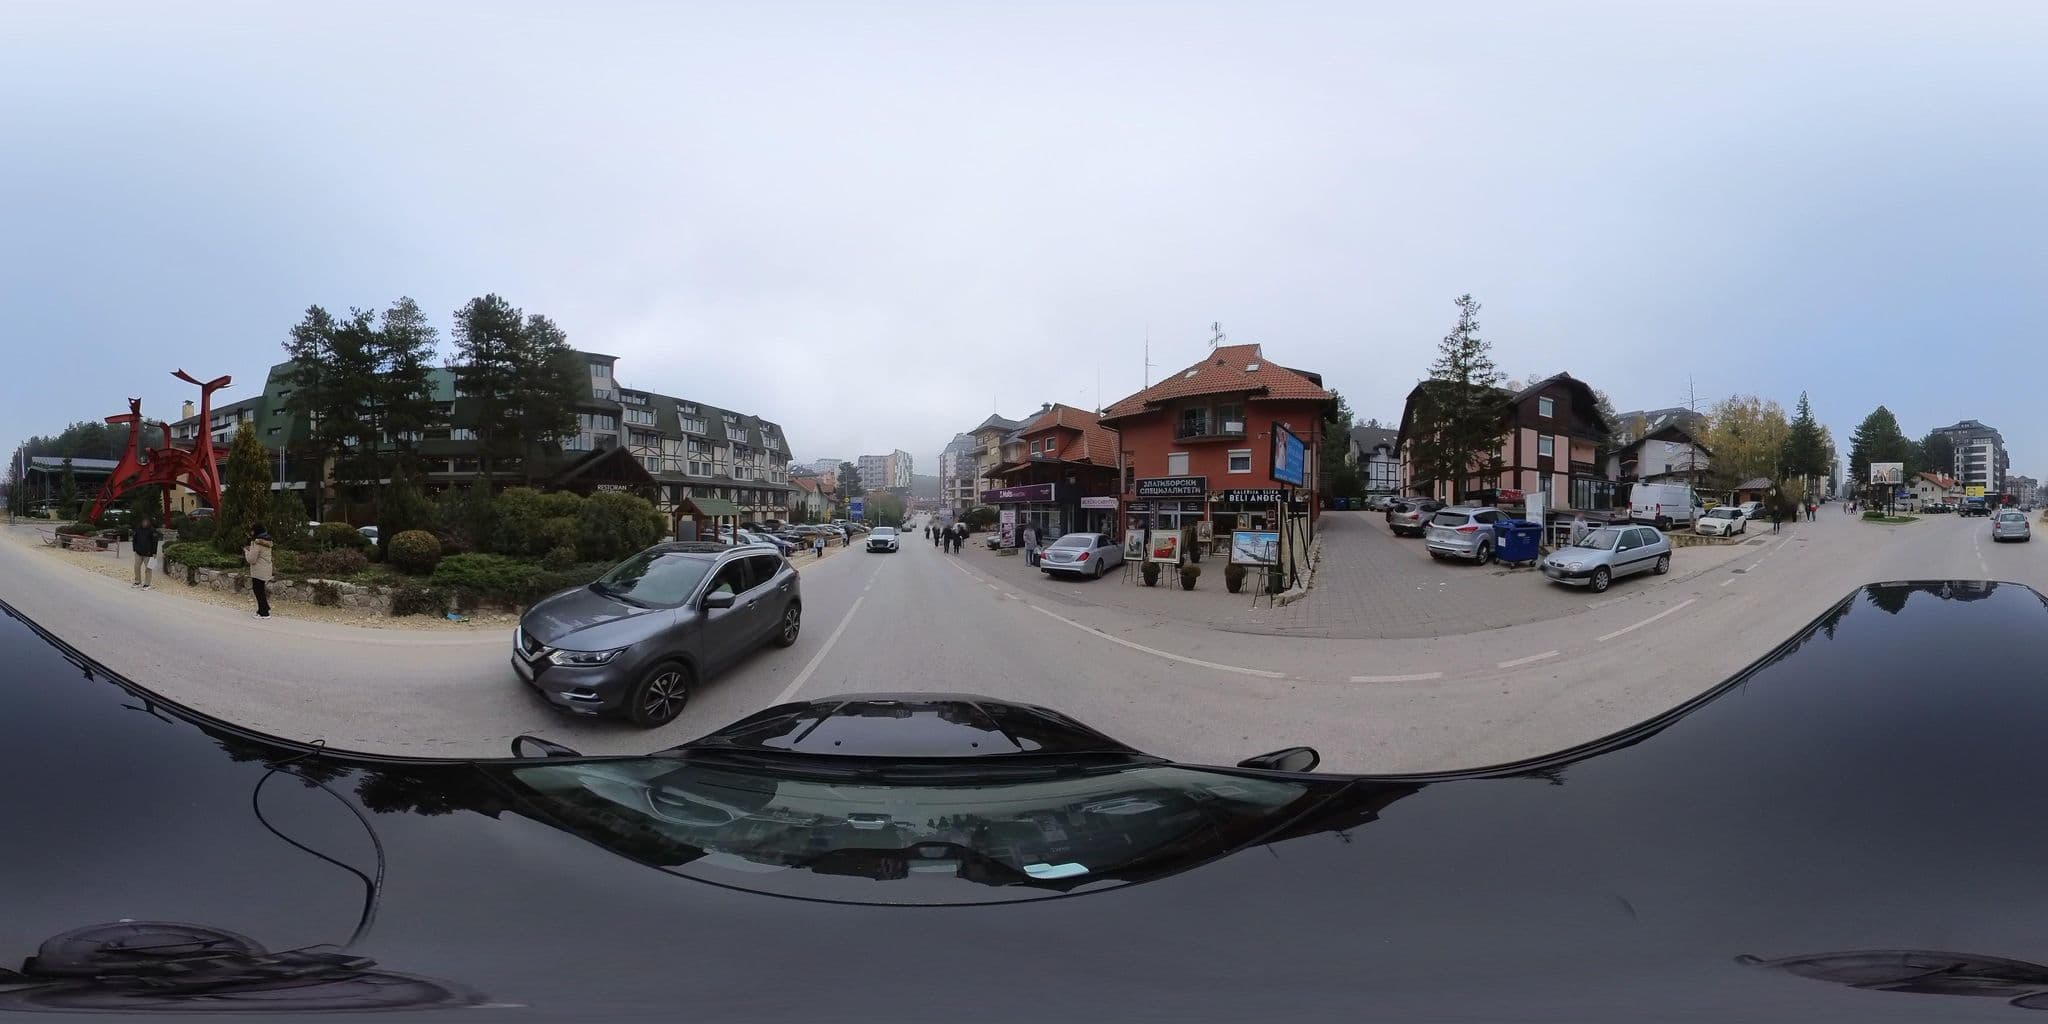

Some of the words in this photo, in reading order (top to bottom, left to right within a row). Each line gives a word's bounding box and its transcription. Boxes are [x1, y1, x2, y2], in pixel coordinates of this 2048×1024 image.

[1143, 479, 1197, 488] ЗЛАТИБОРСКИ
[1140, 487, 1201, 495] СПЕЦИЈАЛИТЕТИ
[1229, 494, 1248, 502] BELI
